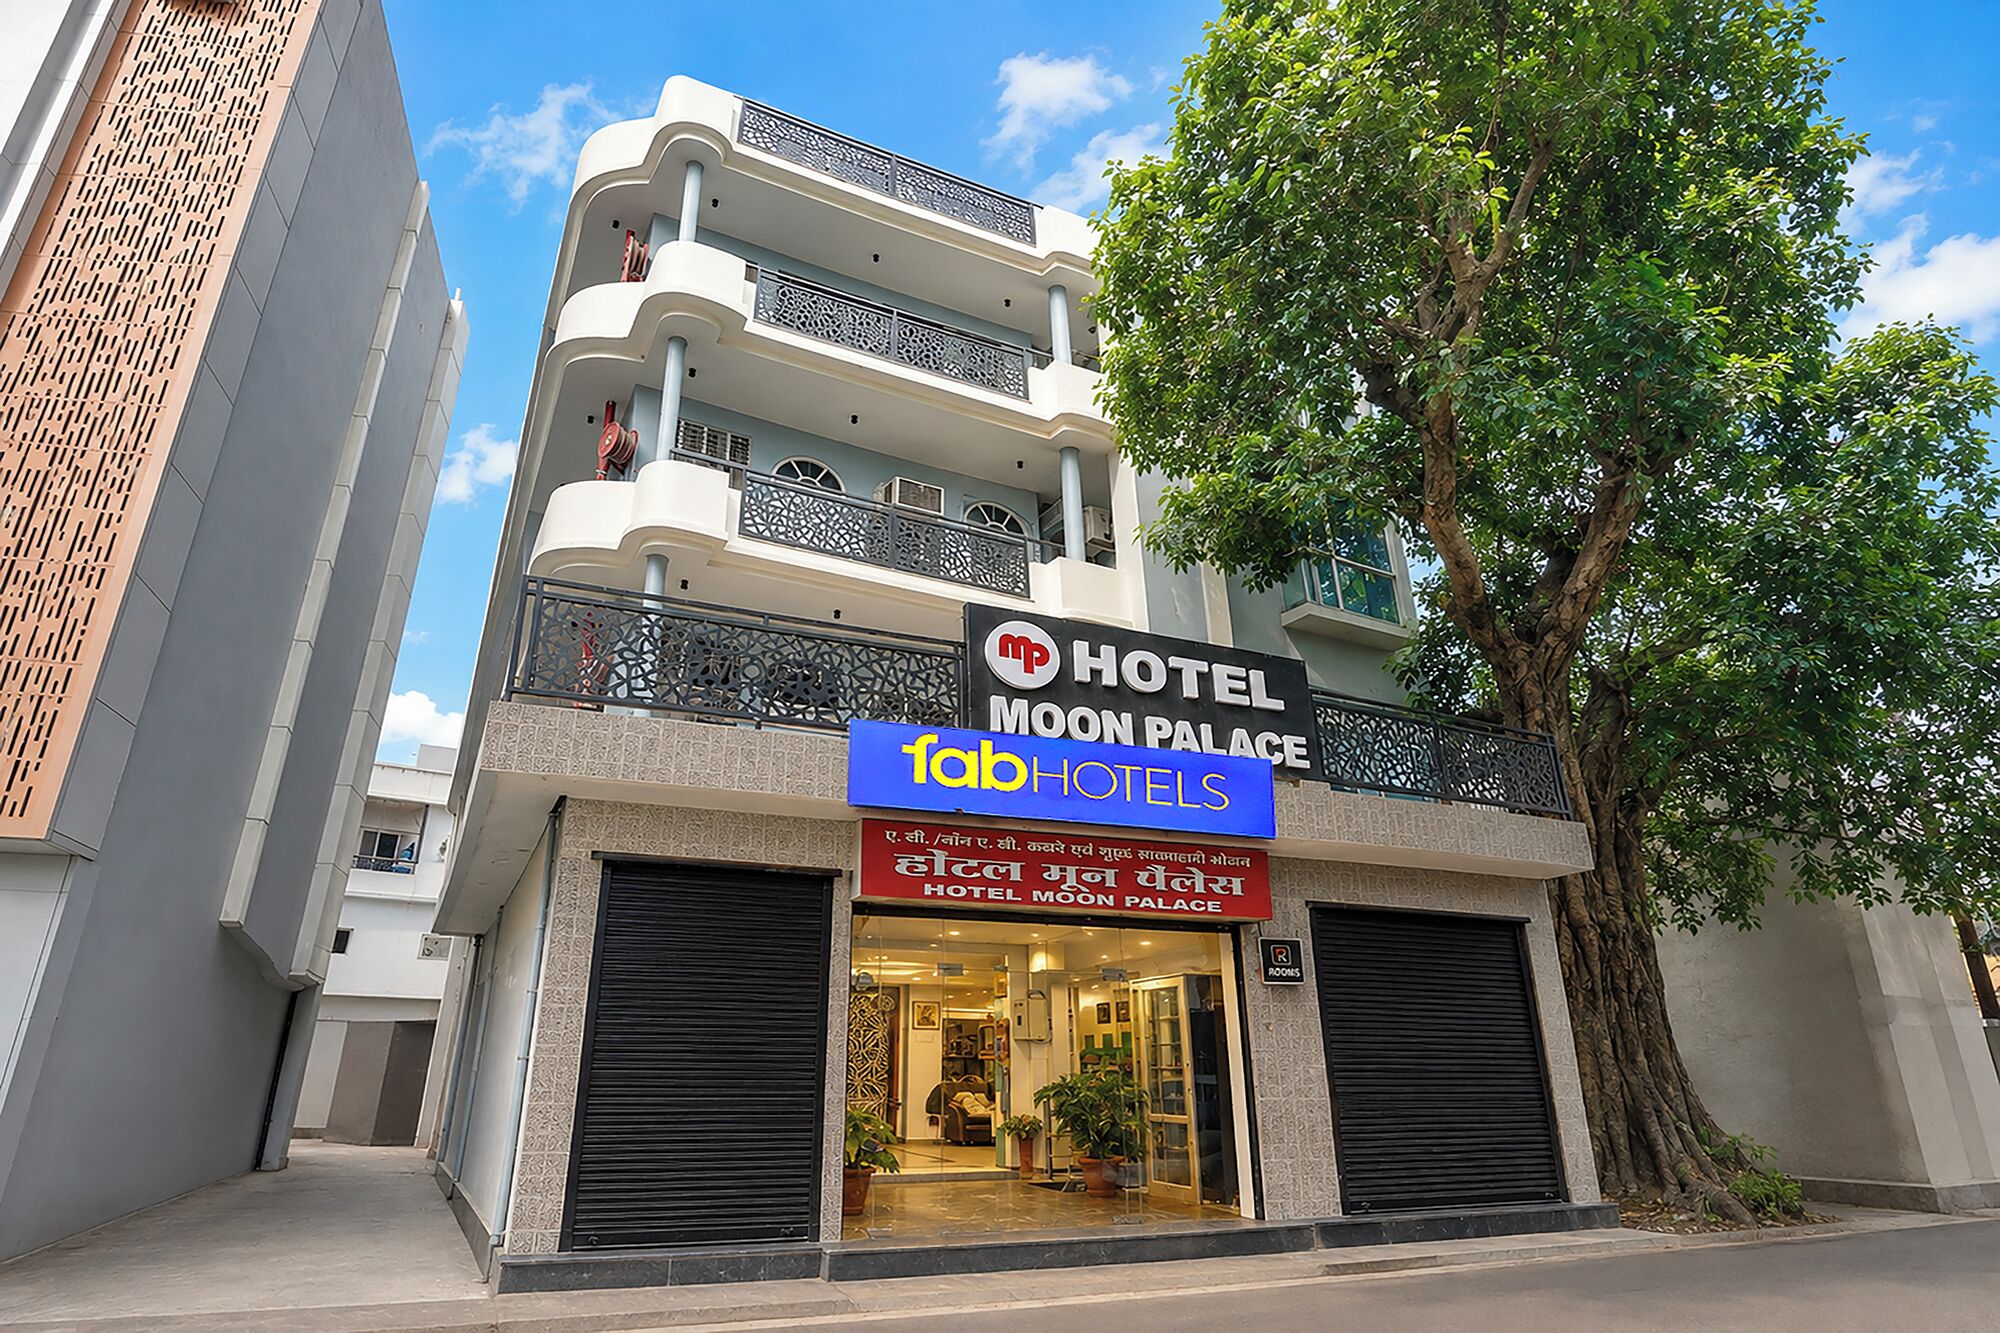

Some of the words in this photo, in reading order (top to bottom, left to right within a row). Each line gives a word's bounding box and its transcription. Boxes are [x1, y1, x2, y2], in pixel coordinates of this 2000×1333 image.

[1072, 639, 1286, 711] HOTEL
[989, 694, 1133, 745] MOON
[1144, 715, 1311, 769] PALACE
[1041, 863, 1119, 892] मून
[1134, 864, 1245, 896] पैलेस
[923, 883, 1022, 901] HOTEL
[1032, 890, 1115, 907] MOON
[1125, 895, 1222, 913] PALACE
[1268, 967, 1301, 977] ROOMS
